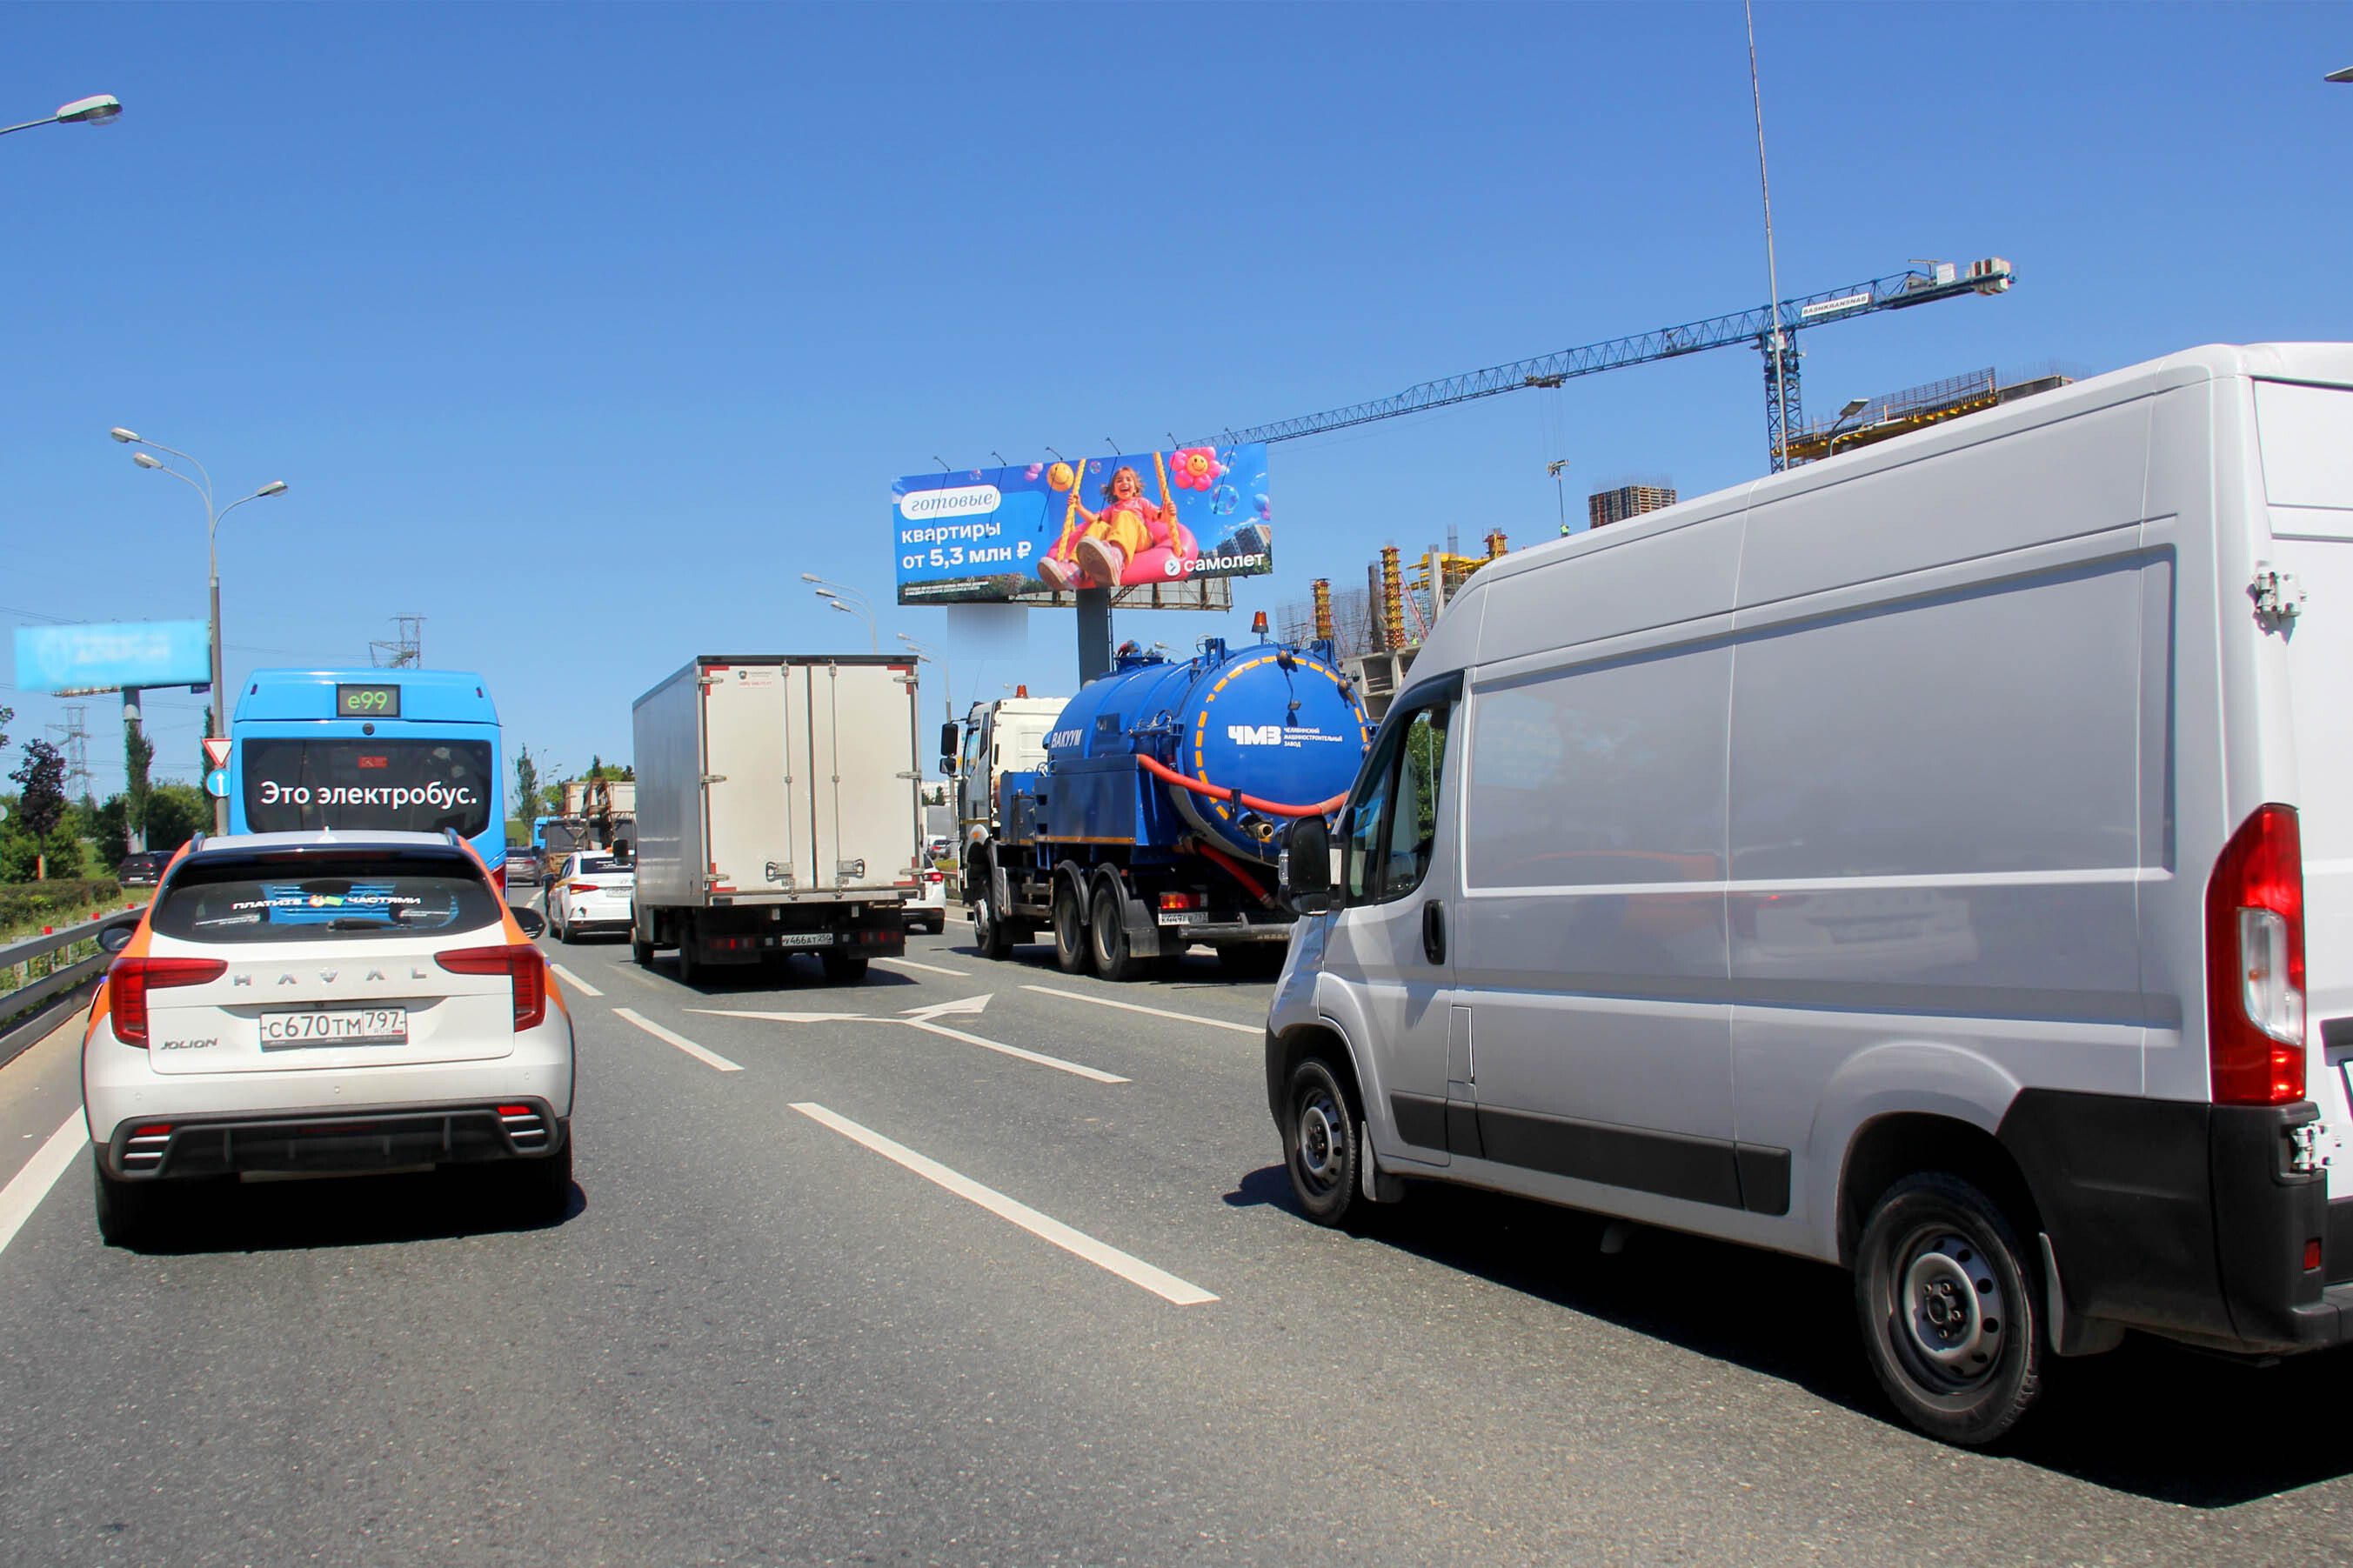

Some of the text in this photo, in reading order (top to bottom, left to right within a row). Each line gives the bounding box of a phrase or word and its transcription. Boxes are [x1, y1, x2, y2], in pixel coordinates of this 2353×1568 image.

[911, 492, 993, 512] готовые
[901, 522, 1000, 544] квартиры
[902, 554, 925, 570] от
[930, 547, 964, 569] 5,3
[969, 547, 1012, 563] млн
[1184, 553, 1265, 572] самолет
[1051, 729, 1083, 748] ВАКУУМ
[1227, 725, 1282, 745] ЧМЗ
[261, 781, 478, 810] Это электробус.
[232, 897, 302, 910] ПЛАТИТЕ
[232, 967, 428, 986] HAVAL
[269, 1011, 398, 1038] С670ТМ 797
[160, 1038, 217, 1051] JOLION
